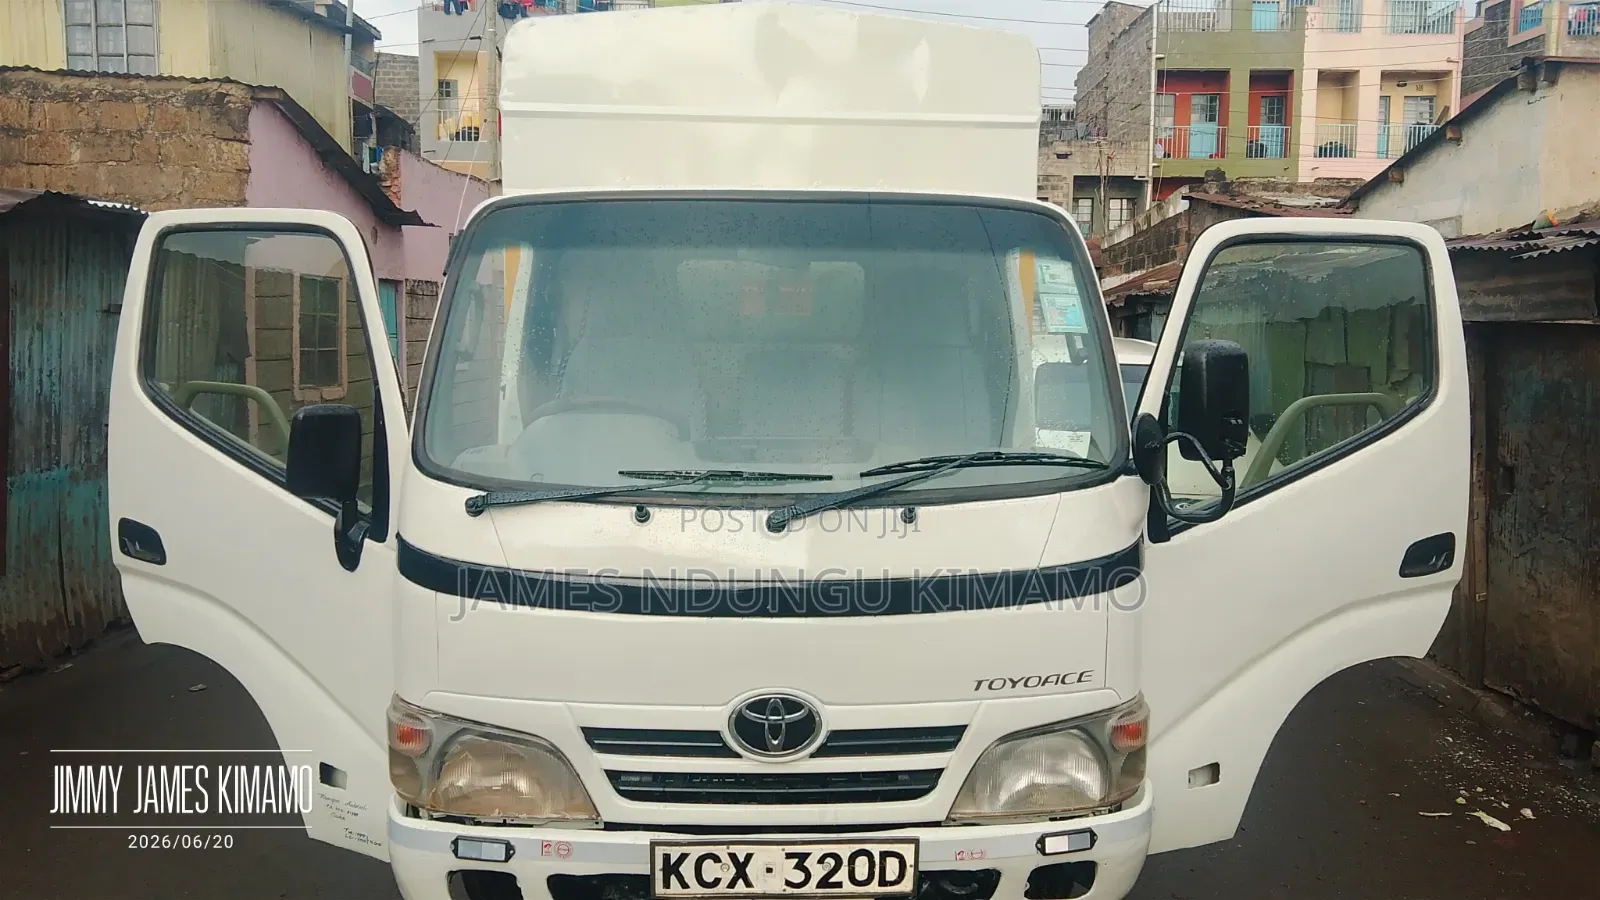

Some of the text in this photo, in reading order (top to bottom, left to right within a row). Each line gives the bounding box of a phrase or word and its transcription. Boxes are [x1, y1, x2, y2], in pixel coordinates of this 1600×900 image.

[973, 669, 1094, 692] TOYOACE
[661, 848, 907, 889] KCX 320D
